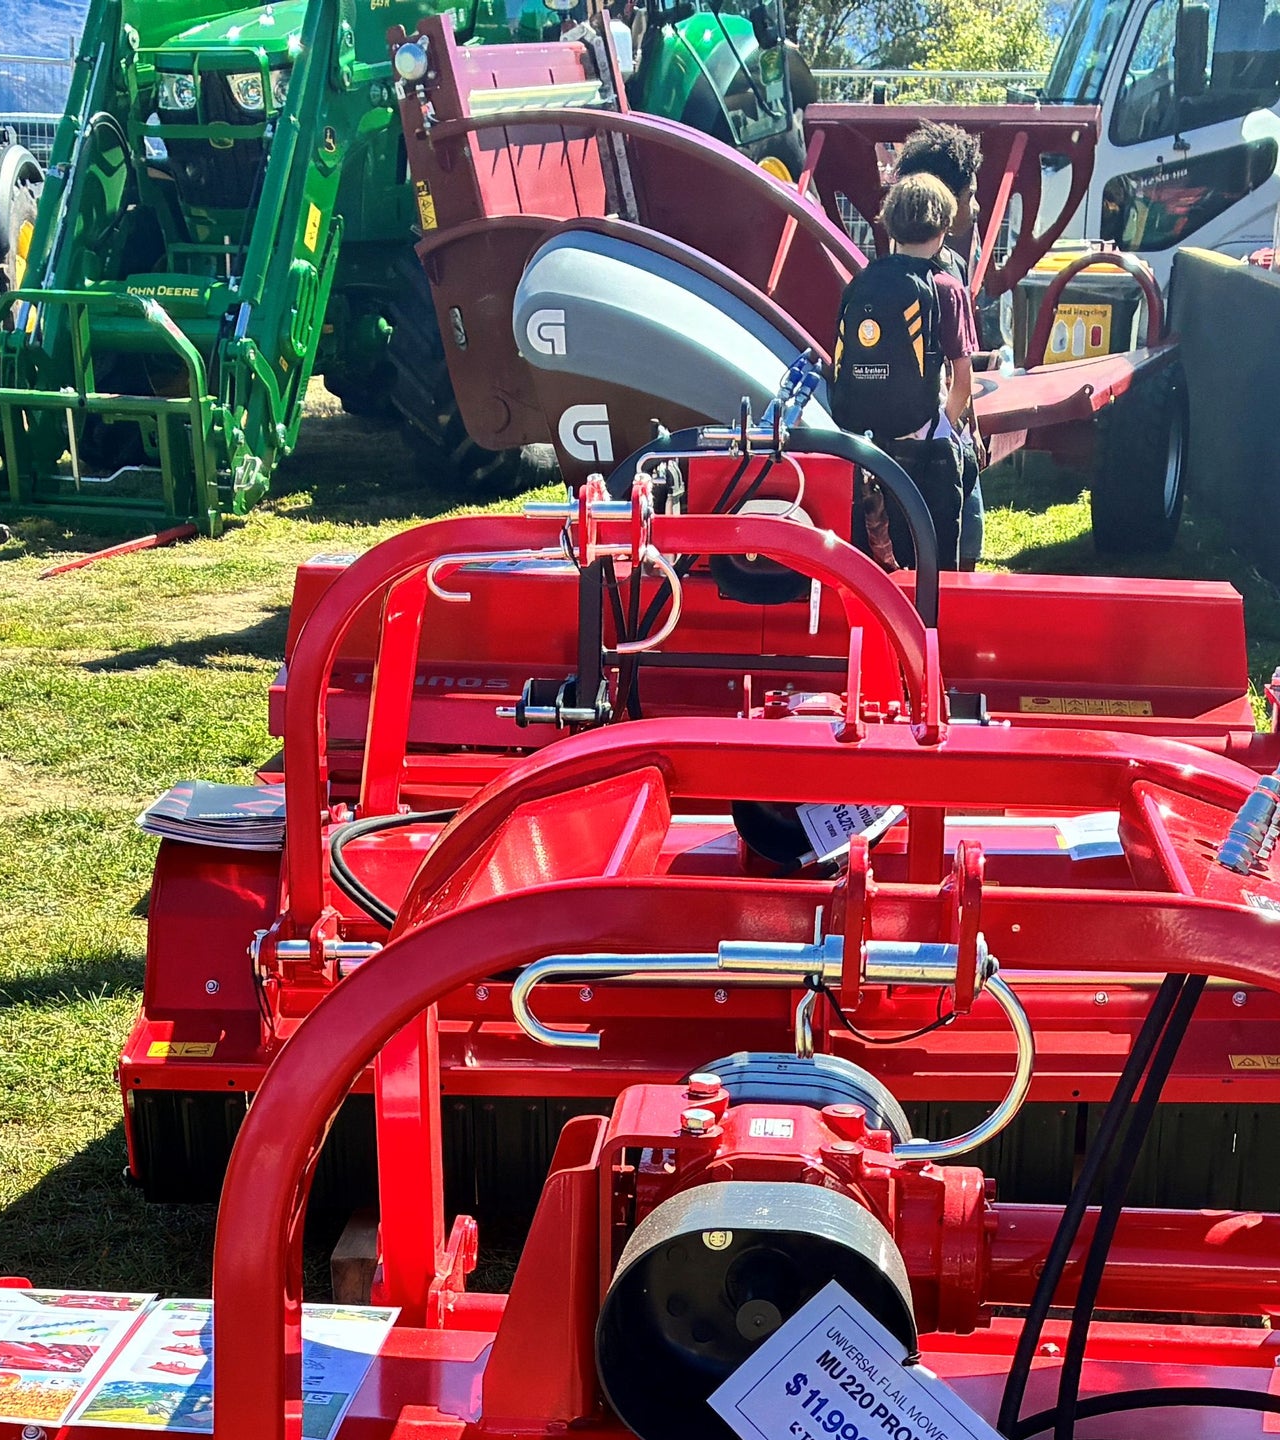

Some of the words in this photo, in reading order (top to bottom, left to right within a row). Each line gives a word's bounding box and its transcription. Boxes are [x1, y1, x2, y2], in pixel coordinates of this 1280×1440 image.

[126, 286, 155, 296] JOHN
[157, 285, 200, 297] DEERE
[785, 1371, 809, 1397] $
[815, 1348, 848, 1381] MU
[840, 1374, 875, 1410] 220
[826, 1326, 882, 1383] UNIVERSAL
[877, 1377, 908, 1412] FLAIL
